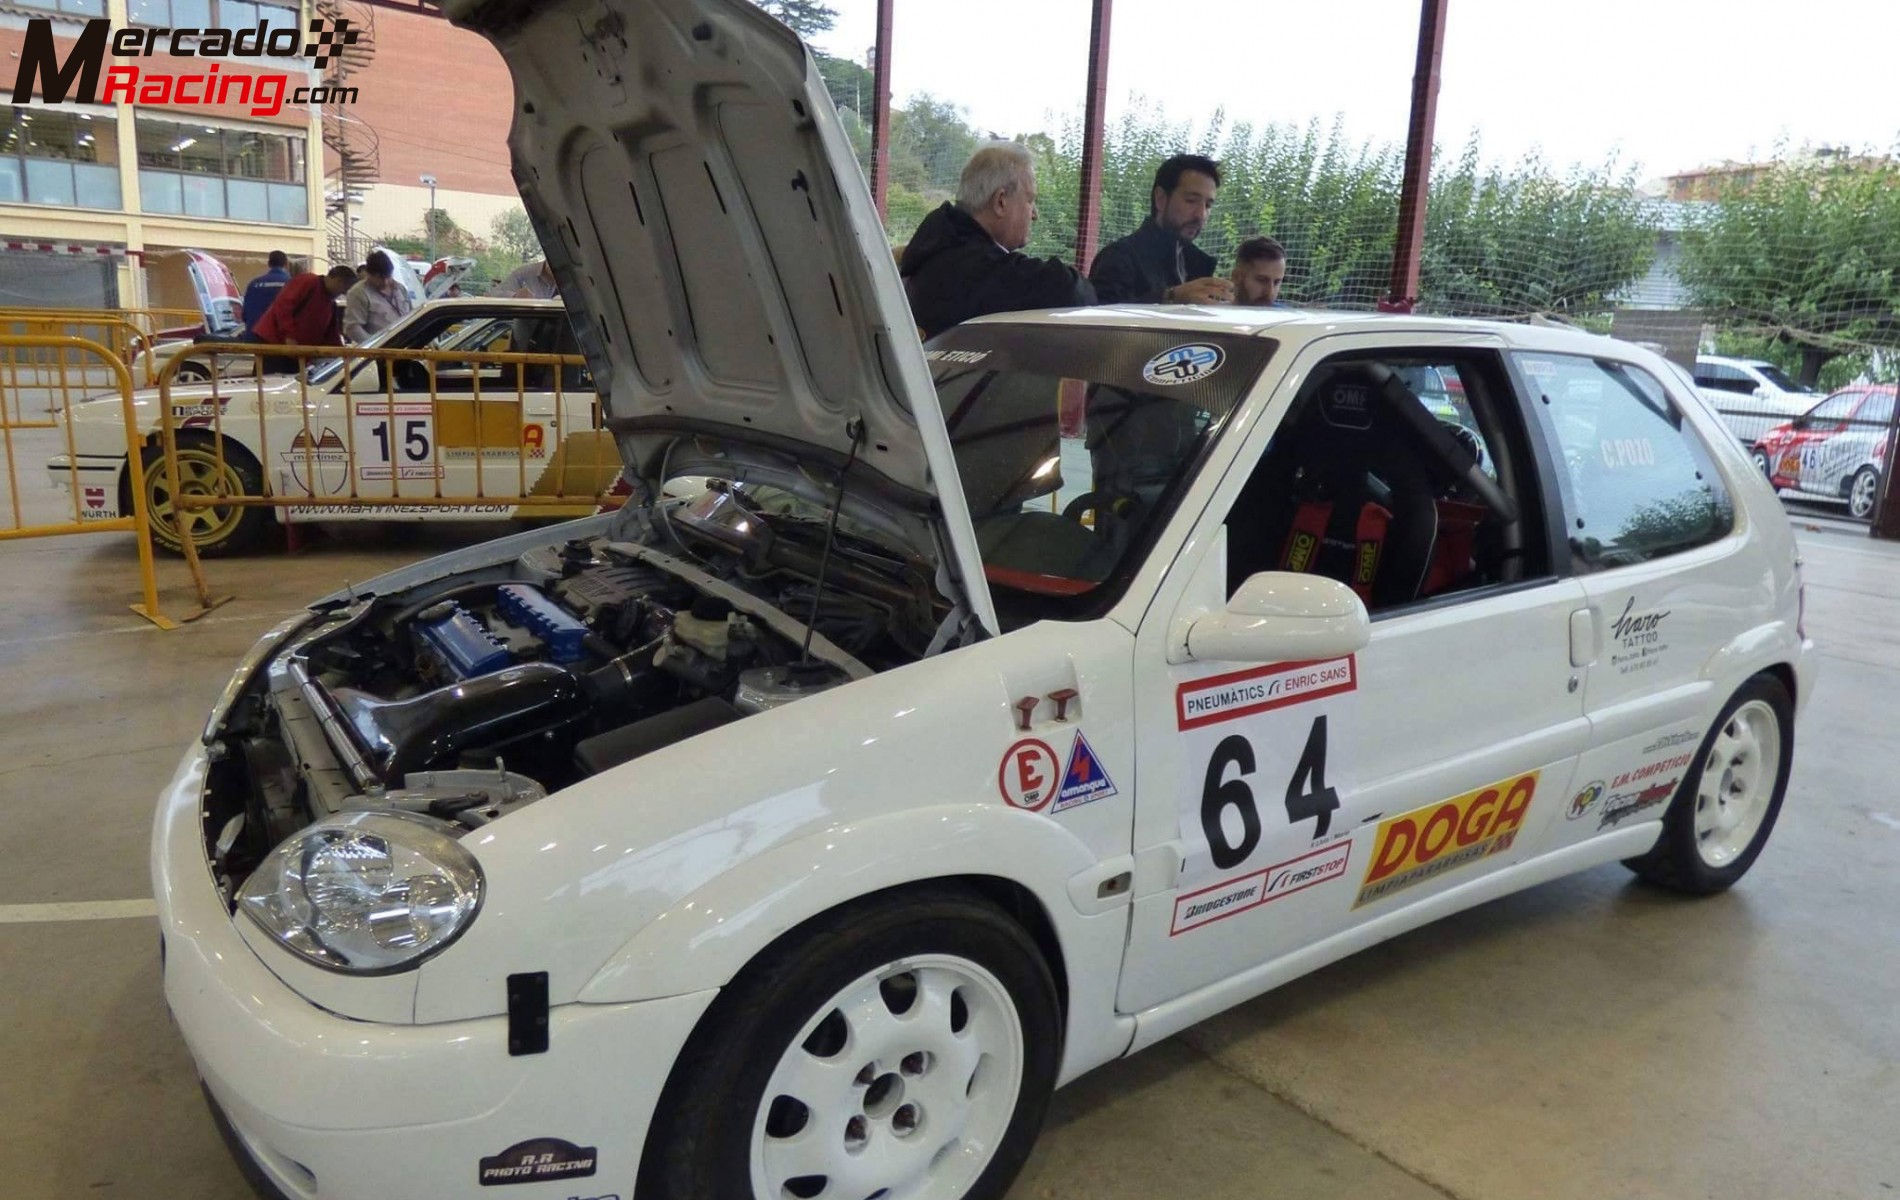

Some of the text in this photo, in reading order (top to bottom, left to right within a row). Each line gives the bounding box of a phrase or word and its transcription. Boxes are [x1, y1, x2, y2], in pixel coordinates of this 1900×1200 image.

[294, 453, 344, 461] mrtinez
[372, 420, 430, 463] 15
[1802, 449, 1816, 470] 46
[1611, 595, 1671, 640] haro
[1622, 631, 1658, 648] TATTOO
[1187, 666, 1347, 714] PNEUMÀTICS ENRIC SANS
[1017, 749, 1044, 793] E
[1200, 715, 1341, 871] 64
[1366, 776, 1537, 884] DOGA
[1289, 857, 1345, 886] FIRSTSTOP
[1358, 843, 1489, 903] LIMPIAPARABRISAS
[1183, 886, 1258, 920] BRIDGESTONE
[483, 1158, 594, 1179] PHOTO RACING
